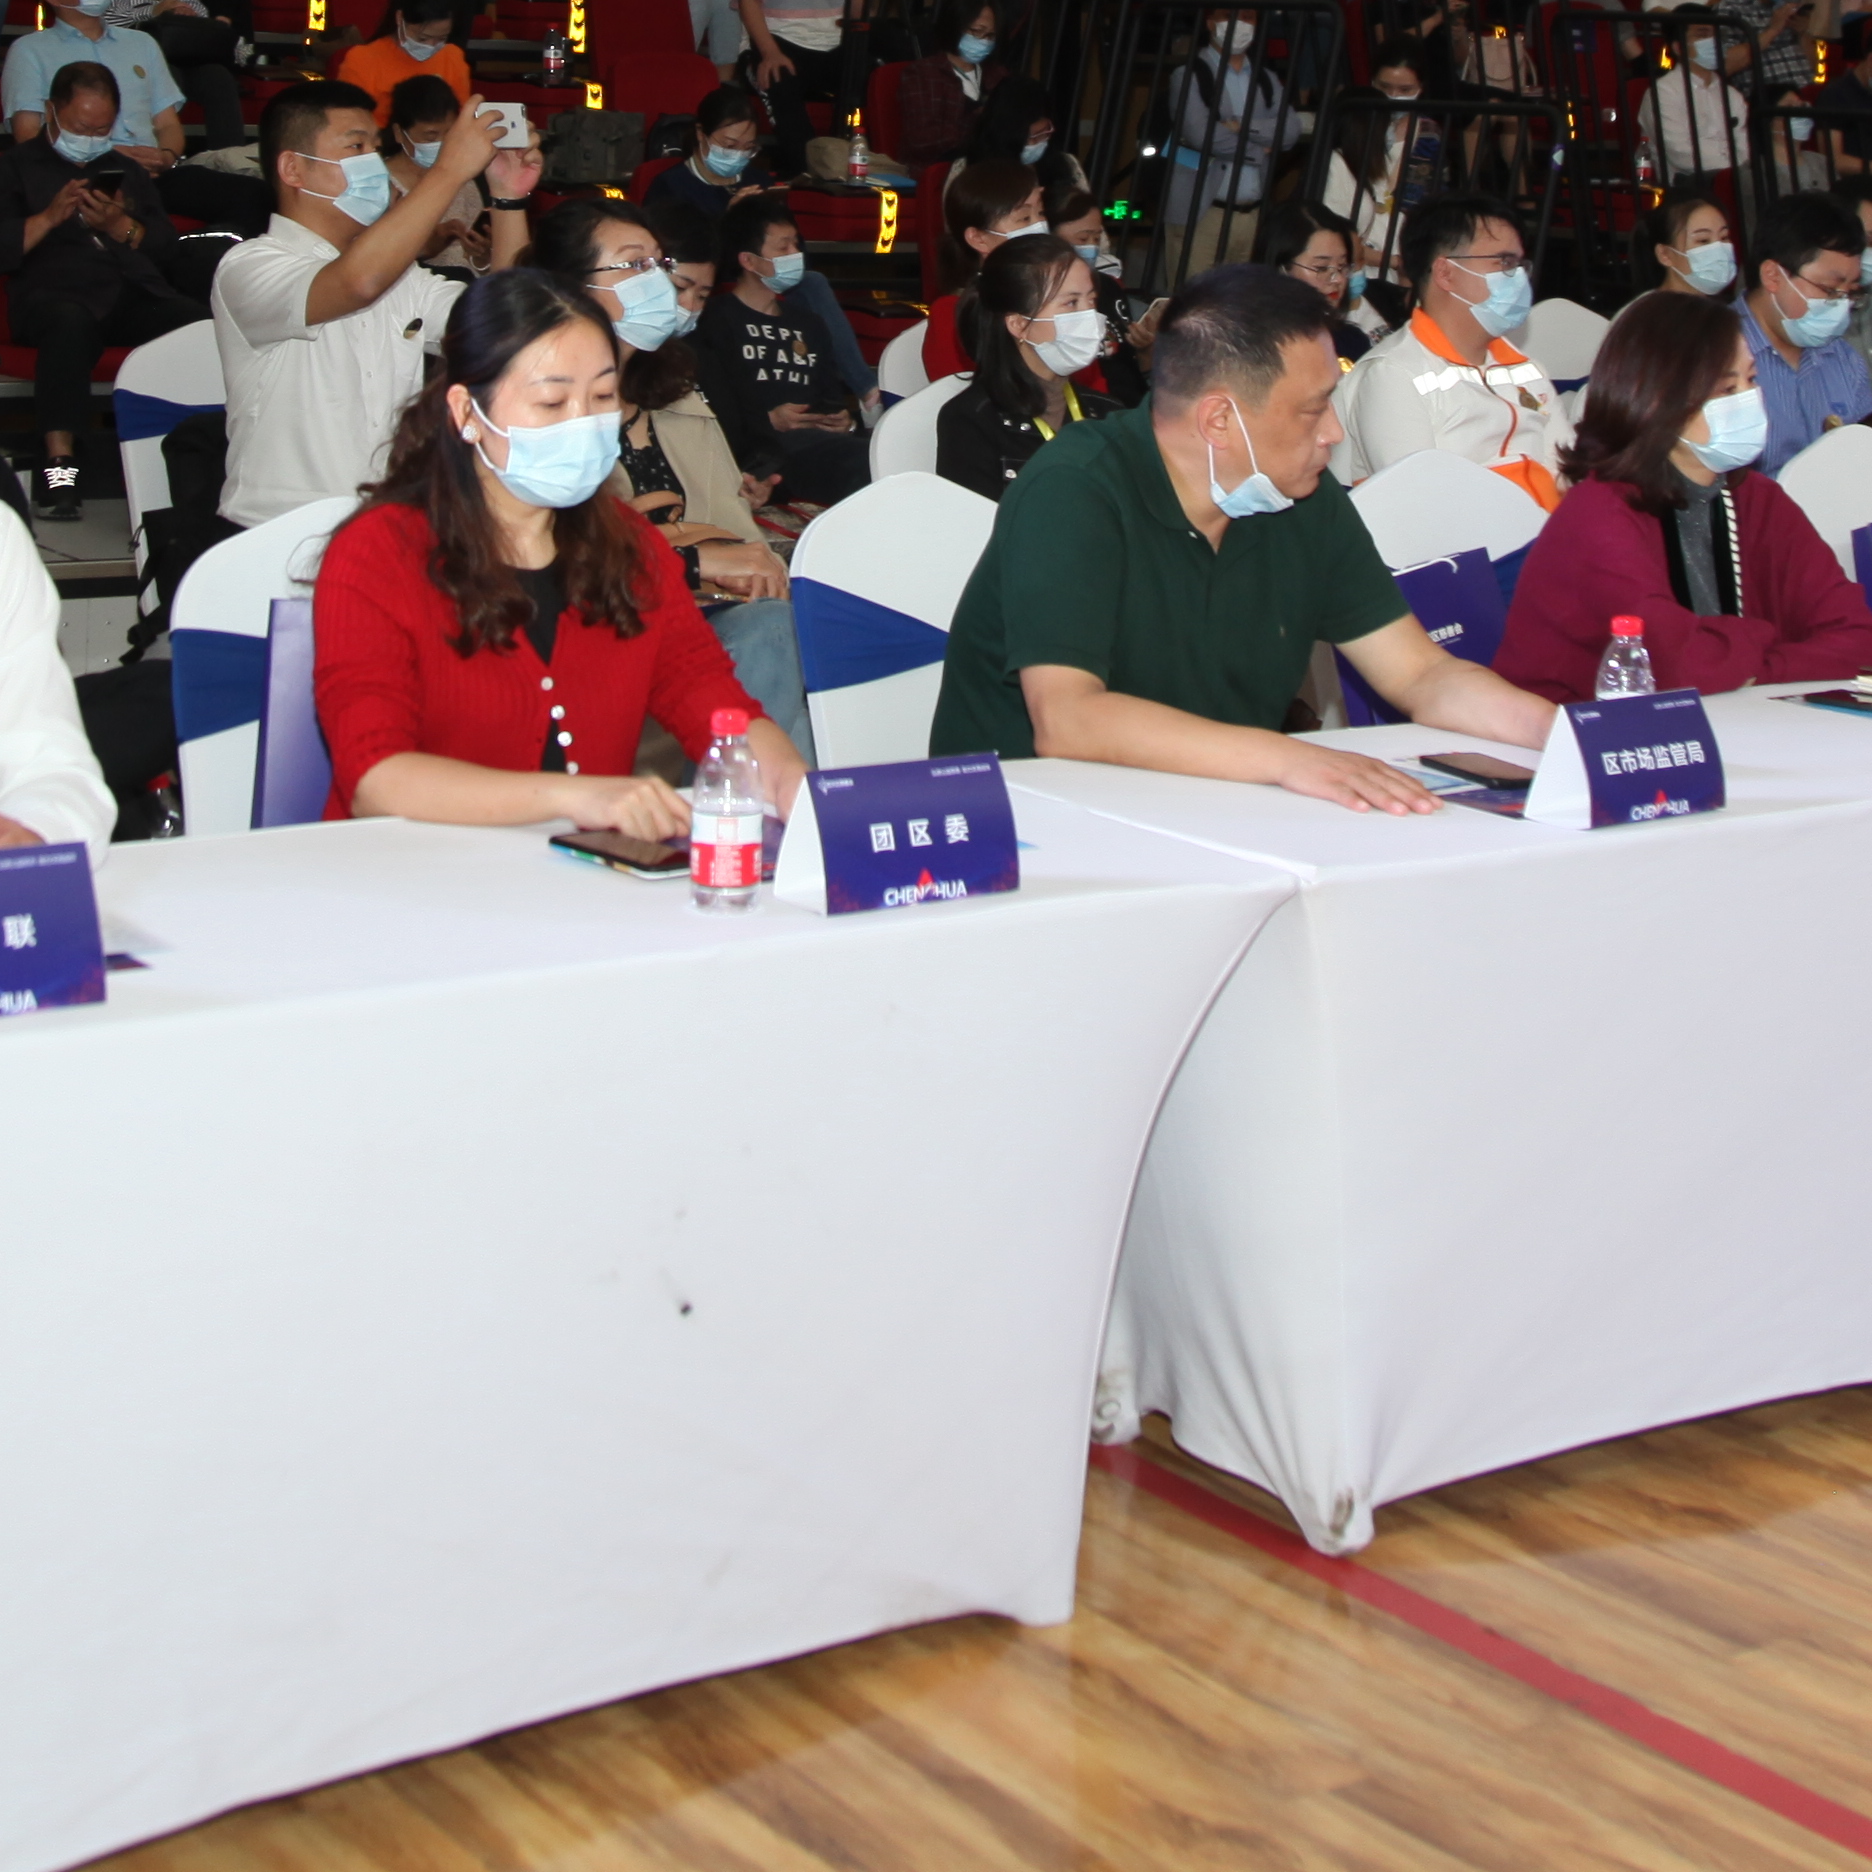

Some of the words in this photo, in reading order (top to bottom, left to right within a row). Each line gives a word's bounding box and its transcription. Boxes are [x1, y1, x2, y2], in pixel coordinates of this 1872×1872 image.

[746, 324, 802, 342] DEPT
[742, 345, 767, 360] OF
[1601, 740, 1705, 775] 区市场监管局
[869, 813, 969, 853] 团区委
